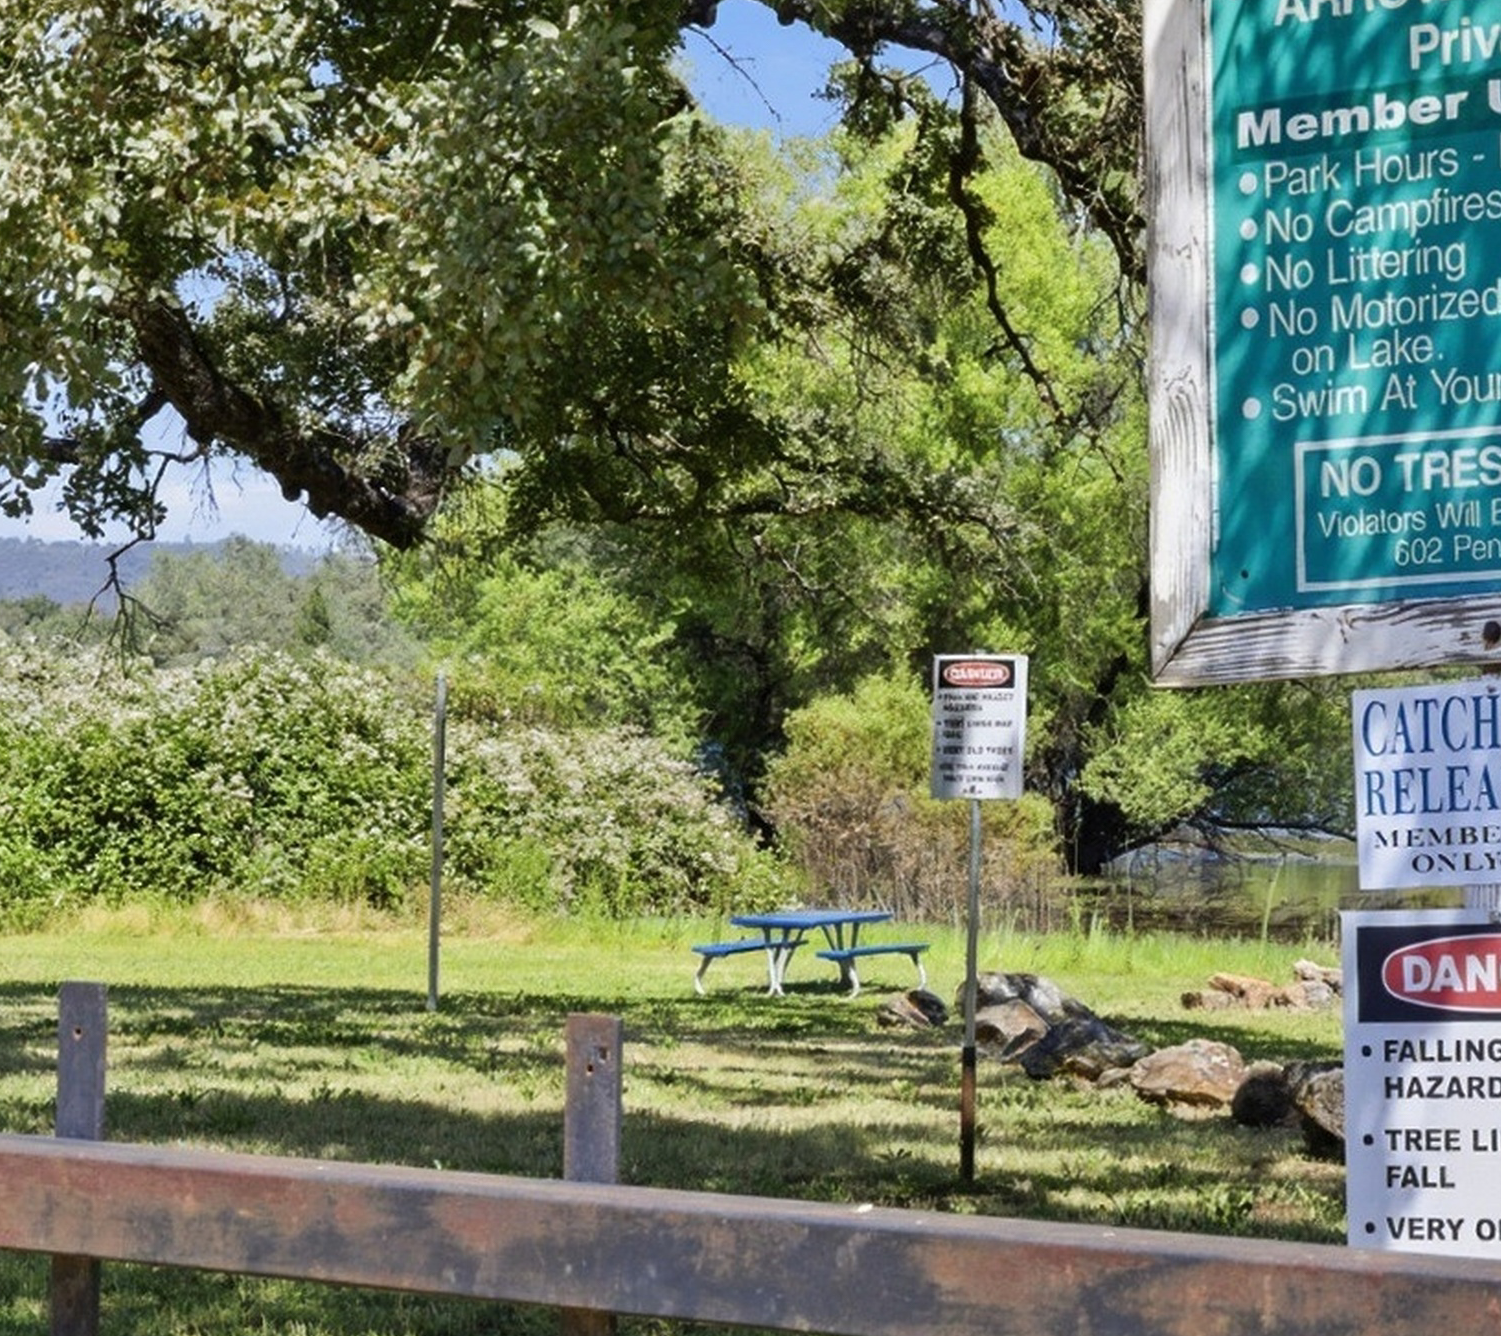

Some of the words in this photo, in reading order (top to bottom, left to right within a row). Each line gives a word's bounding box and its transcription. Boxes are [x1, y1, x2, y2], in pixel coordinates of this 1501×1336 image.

[1237, 89, 1468, 149] Member
[1265, 156, 1341, 198] Park
[1355, 145, 1458, 187] Hours
[1264, 208, 1313, 245] No
[1266, 255, 1314, 292] No
[1328, 240, 1467, 285] Littering
[1269, 302, 1317, 338] No
[1331, 278, 1501, 332] Motorized
[1292, 343, 1333, 375] on
[1272, 381, 1366, 421] Swim
[1381, 373, 1417, 410] At
[1320, 456, 1381, 498] NO
[1318, 508, 1426, 538] Violators
[1436, 501, 1481, 529] Will
[1395, 539, 1443, 566] 602
[1362, 694, 1501, 756] CATCH
[1385, 1129, 1461, 1152] TREE
[1386, 1165, 1455, 1189] FALL
[1386, 1217, 1465, 1241] VERY
